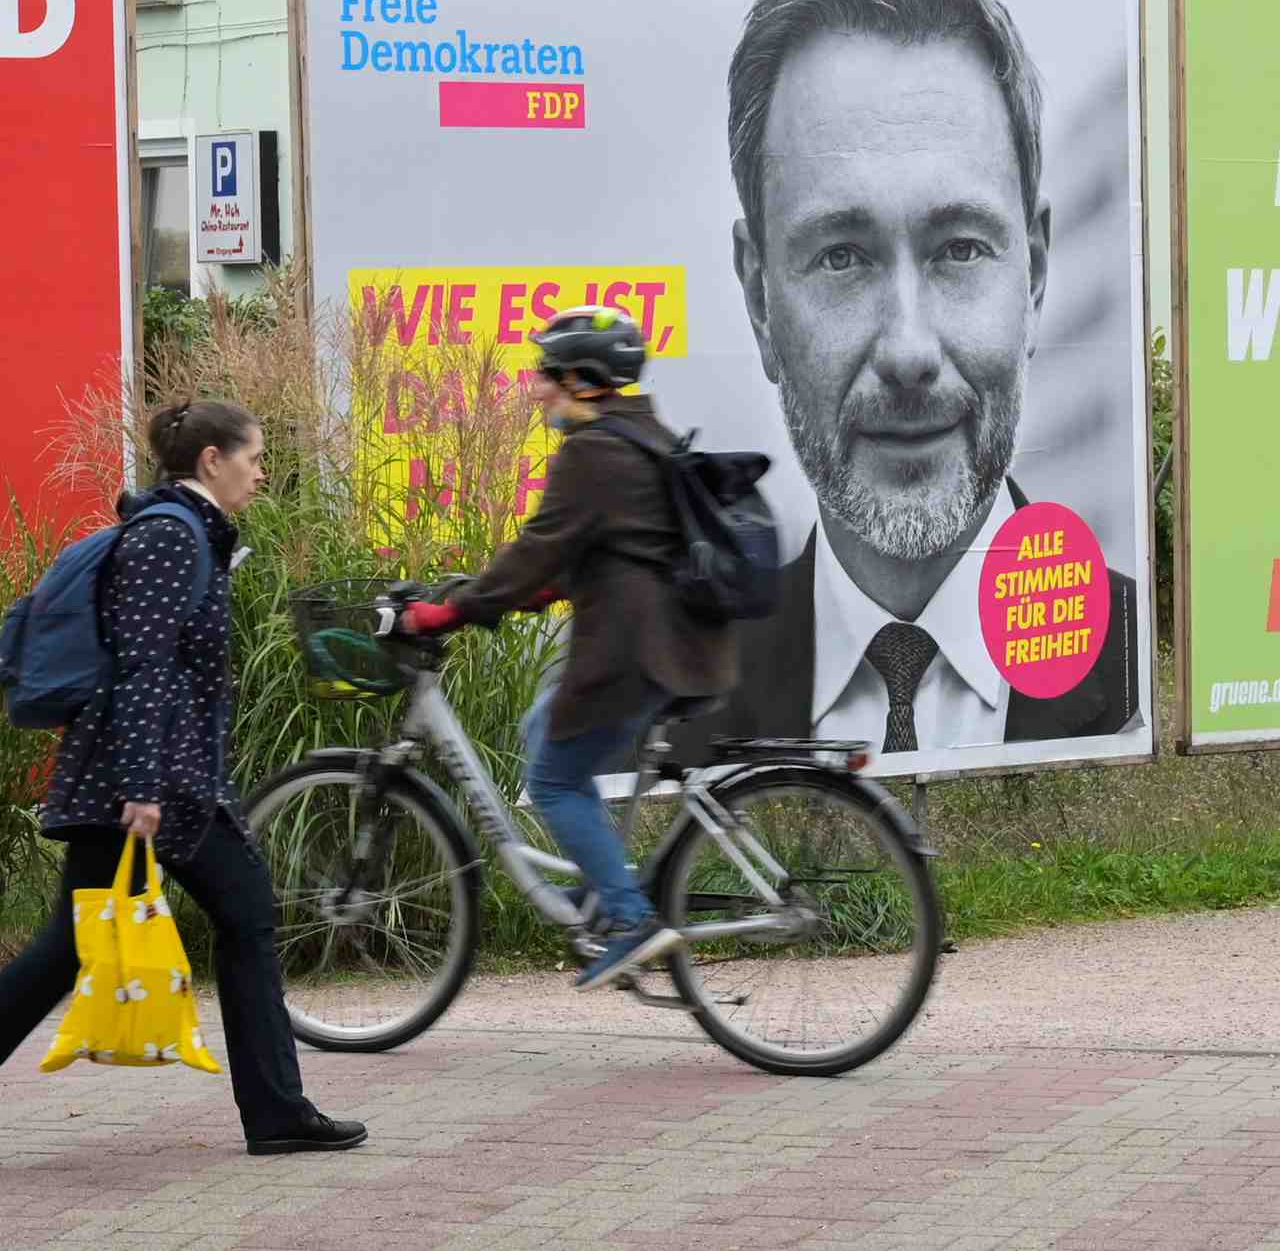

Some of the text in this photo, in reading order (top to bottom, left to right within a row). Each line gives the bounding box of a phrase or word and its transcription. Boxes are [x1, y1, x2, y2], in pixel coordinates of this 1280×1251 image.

[339, 29, 586, 75] Demokraten
[526, 91, 580, 120] FDP
[216, 147, 233, 192] P
[361, 283, 477, 348] WIE
[497, 281, 562, 345] ES
[1017, 530, 1065, 561] ALLE
[994, 559, 1092, 600] STIMMEN
[1006, 594, 1086, 632] FÜR DIE
[1005, 627, 1092, 667] FREIHEIT
